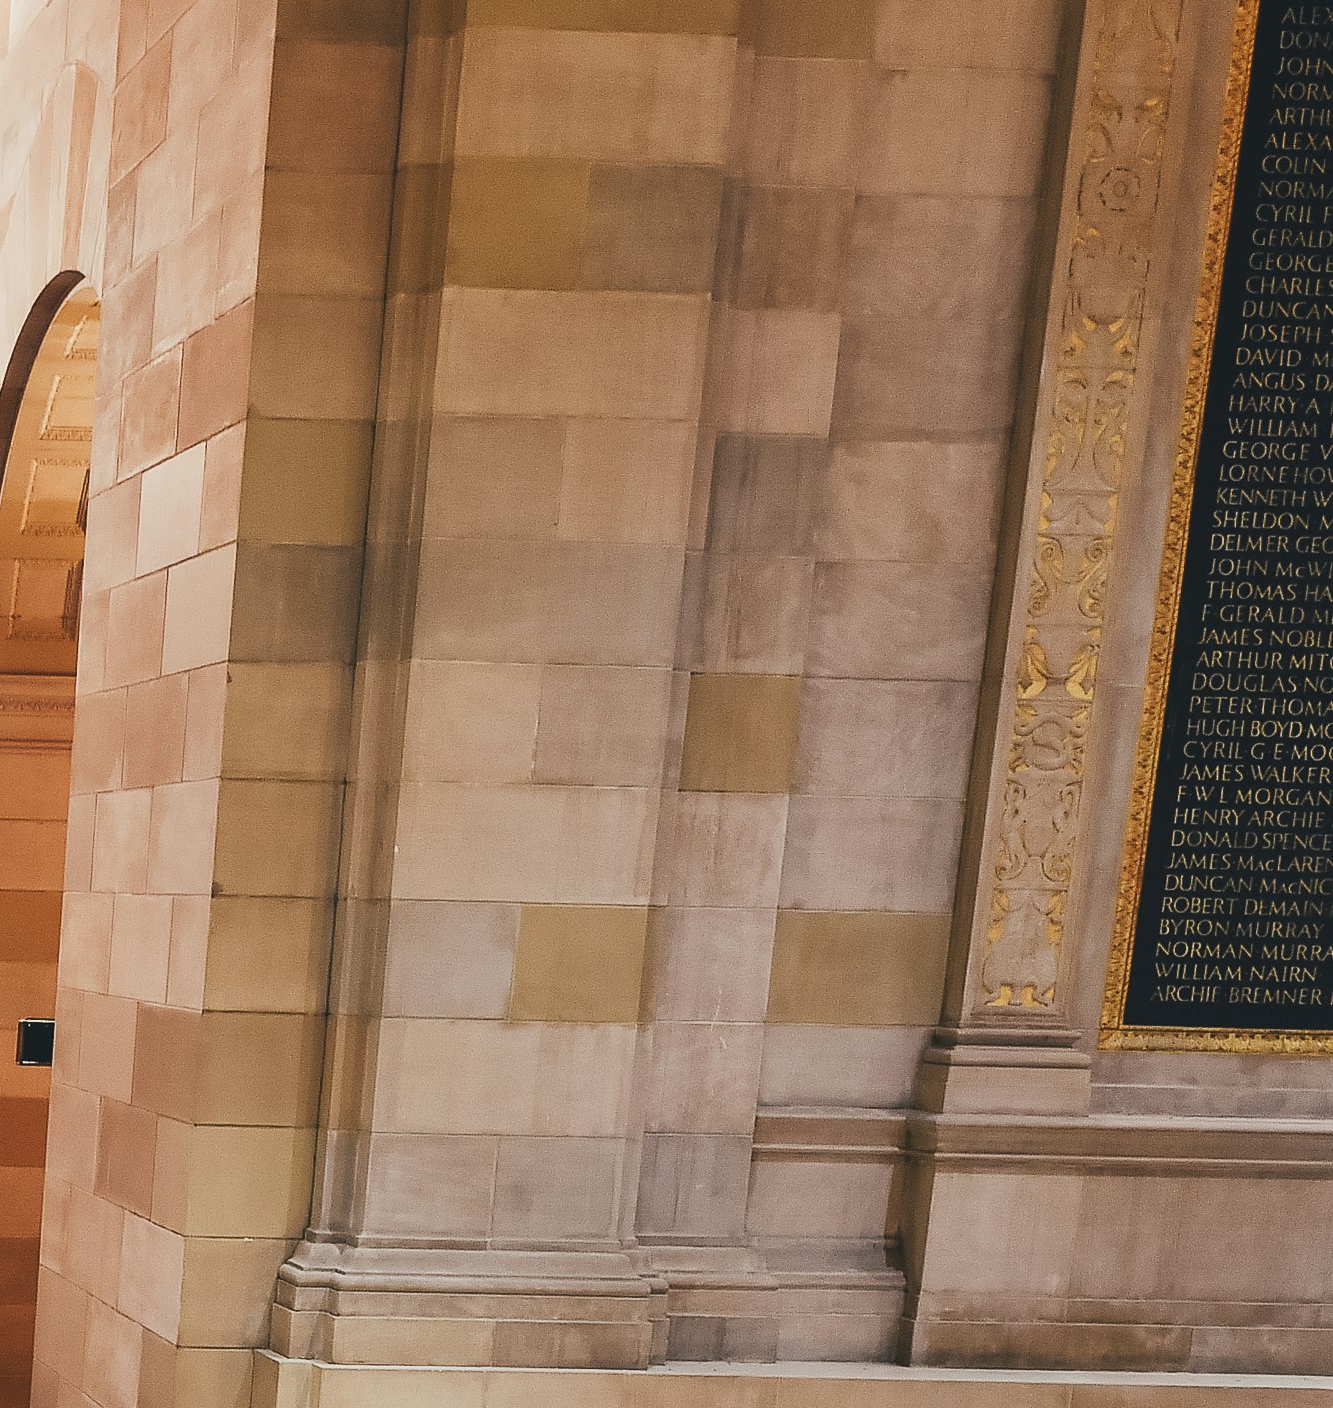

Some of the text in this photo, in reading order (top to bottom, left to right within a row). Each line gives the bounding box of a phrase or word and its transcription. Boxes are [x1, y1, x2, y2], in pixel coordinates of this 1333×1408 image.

[1262, 155, 1326, 174] COLIN
[1255, 203, 1312, 223] CYRIL
[1240, 324, 1321, 344] JOSEPH
[1235, 347, 1302, 367] DAVID
[1233, 372, 1306, 391] ANGUS
[1229, 395, 1320, 415] HARRY A
[1228, 417, 1317, 438] WILLIAM
[1223, 441, 1311, 461] GEORGE
[1219, 464, 1289, 483] LORNE
[1216, 488, 1306, 507] KENNETH
[1212, 510, 1310, 530] SHELDON
[1210, 533, 1289, 553] DELMER
[1208, 558, 1268, 576] JOHN
[1206, 581, 1298, 601] THOMAS
[1202, 604, 1212, 622] F
[1219, 605, 1305, 625] GERALD
[1197, 627, 1263, 646] JAMES
[1195, 650, 1283, 670] ARTHUR
[1192, 672, 1298, 693] DOUGLAS
[1189, 696, 1252, 715] PETER
[1186, 718, 1245, 737] HUGH
[1251, 720, 1303, 739] BOYD
[1183, 741, 1243, 759] CYRIL
[1251, 742, 1265, 760] G
[1273, 743, 1284, 760] E
[1178, 762, 1331, 784] JAMES WALKER
[1177, 785, 1333, 807] F W L MORGAN
[1173, 808, 1325, 829] HENRY ARCHIE
[1171, 829, 1332, 851] DONALD SPENCE
[1165, 852, 1232, 870] JAMES
[1164, 874, 1253, 893] DUNCAN
[1161, 896, 1324, 917] ROBERT DEMAIN
[1159, 918, 1324, 940] BYRON MURRAY
[1155, 941, 1253, 959] NORMAN
[1155, 963, 1317, 983] WILLIAM NAIRN
[1150, 985, 1322, 1006] ARCHIE BREMNER
